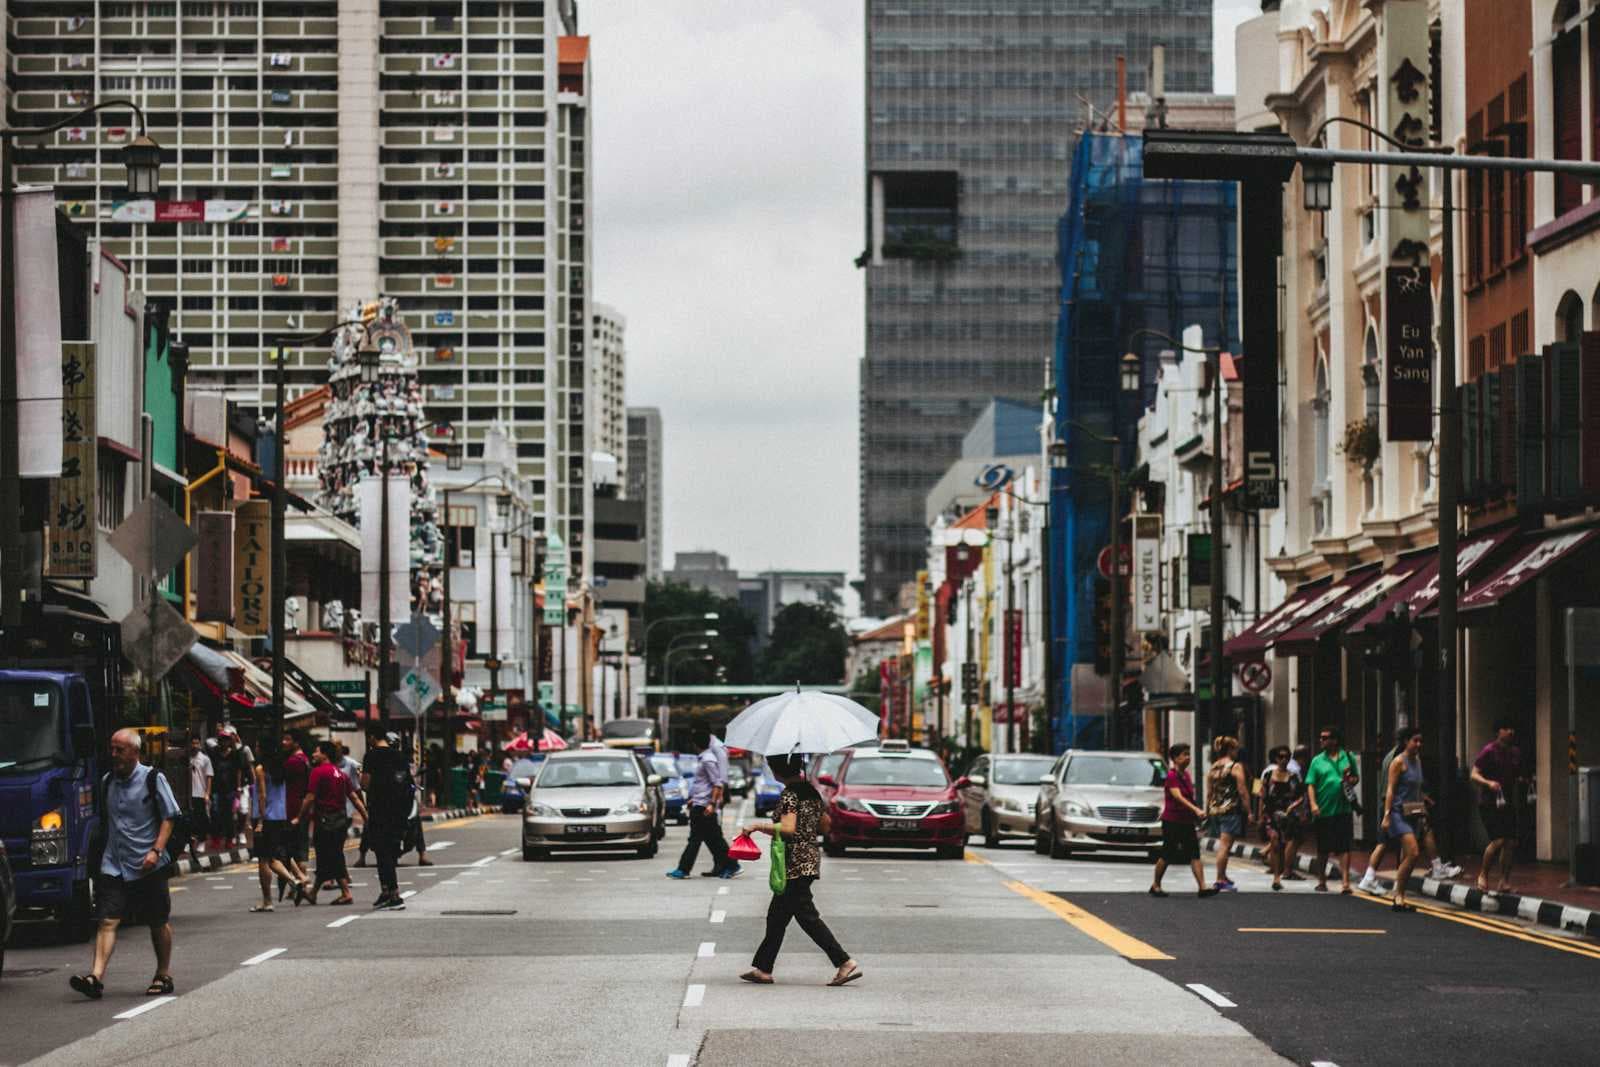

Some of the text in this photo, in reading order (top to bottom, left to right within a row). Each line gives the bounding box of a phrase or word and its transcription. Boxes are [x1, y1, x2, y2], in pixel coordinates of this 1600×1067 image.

[1401, 324, 1420, 339] Eu
[1399, 344, 1424, 360] Yan
[1393, 365, 1430, 384] Sang
[240, 521, 264, 625] TAILORS
[1142, 550, 1154, 604] HOSTEL
